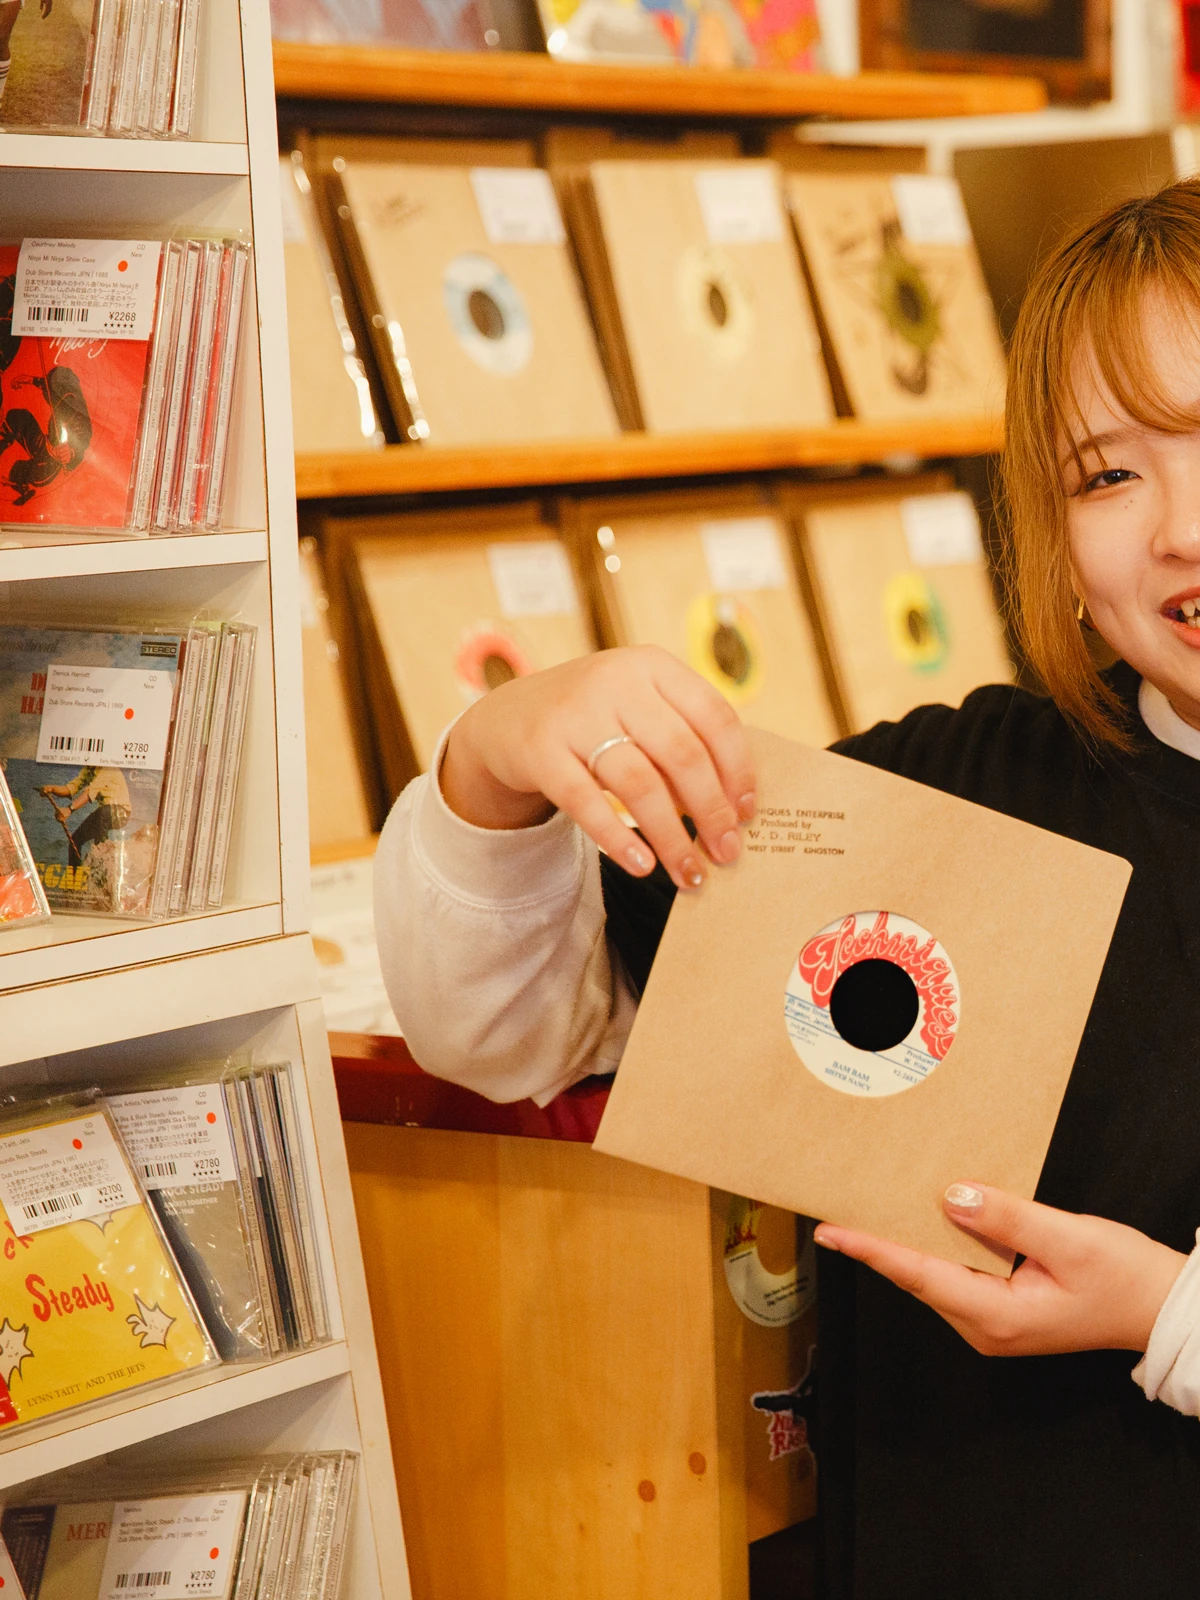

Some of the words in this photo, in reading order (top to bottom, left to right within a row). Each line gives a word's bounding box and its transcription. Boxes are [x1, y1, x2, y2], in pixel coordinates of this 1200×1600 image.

[108, 311, 136, 322] ¥2268
[141, 646, 176, 654] STEREO
[122, 742, 149, 752] ¥2780
[796, 810, 845, 820] ENTERPRISE
[760, 818, 798, 828] Produced
[802, 820, 812, 830] by
[788, 832, 822, 842] RILEY
[804, 847, 845, 856] KINGSTON
[906, 1050, 934, 1066] Produced
[832, 1060, 852, 1074] BAM
[852, 1068, 870, 1082] BAM
[824, 1068, 847, 1082] SISTER
[848, 1076, 871, 1092] NANCY
[15, 1151, 29, 1160] Rock
[193, 1157, 220, 1169] ¥2780
[12, 1166, 28, 1176] Store
[96, 1182, 122, 1197] ¥2700
[25, 1273, 115, 1322] Steady
[26, 1391, 53, 1408] LYNN
[84, 1375, 106, 1390] AND
[106, 1369, 126, 1381] THE
[127, 1362, 146, 1378] JETS
[66, 1522, 108, 1541] MER
[188, 1570, 216, 1580] ¥2780
